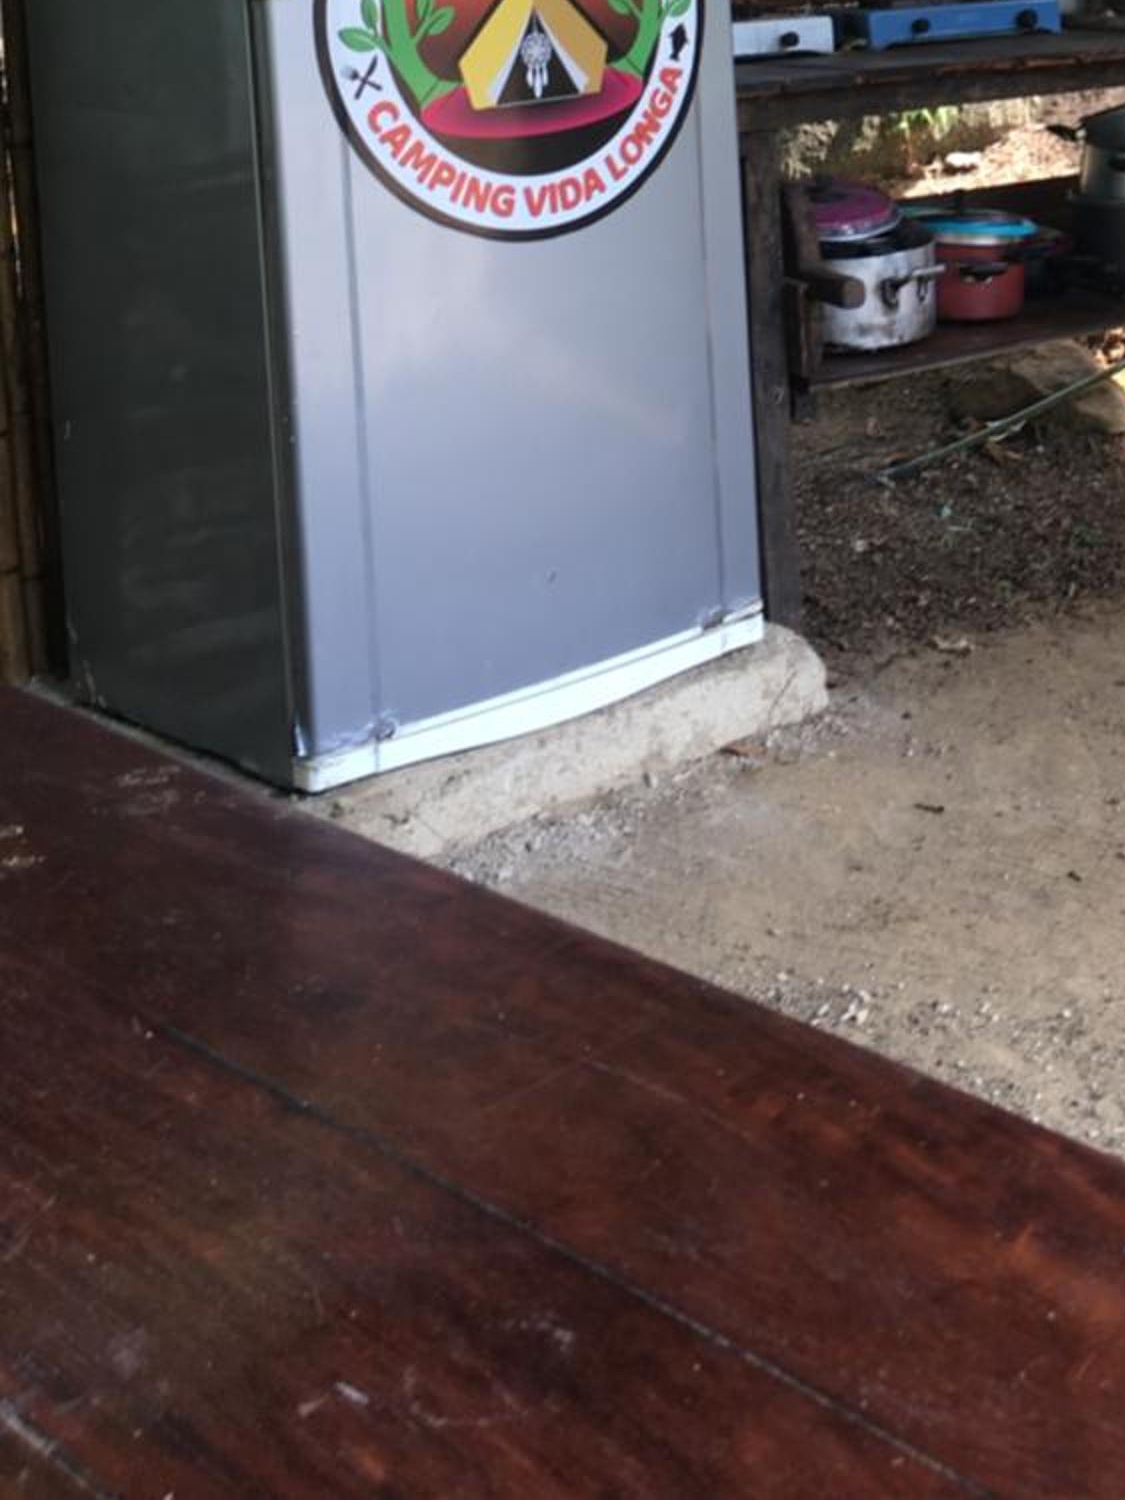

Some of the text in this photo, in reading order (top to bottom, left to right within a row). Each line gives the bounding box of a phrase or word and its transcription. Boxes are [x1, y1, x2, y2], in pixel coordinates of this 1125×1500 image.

[367, 66, 683, 218] CAMPING VIDA LONGA
